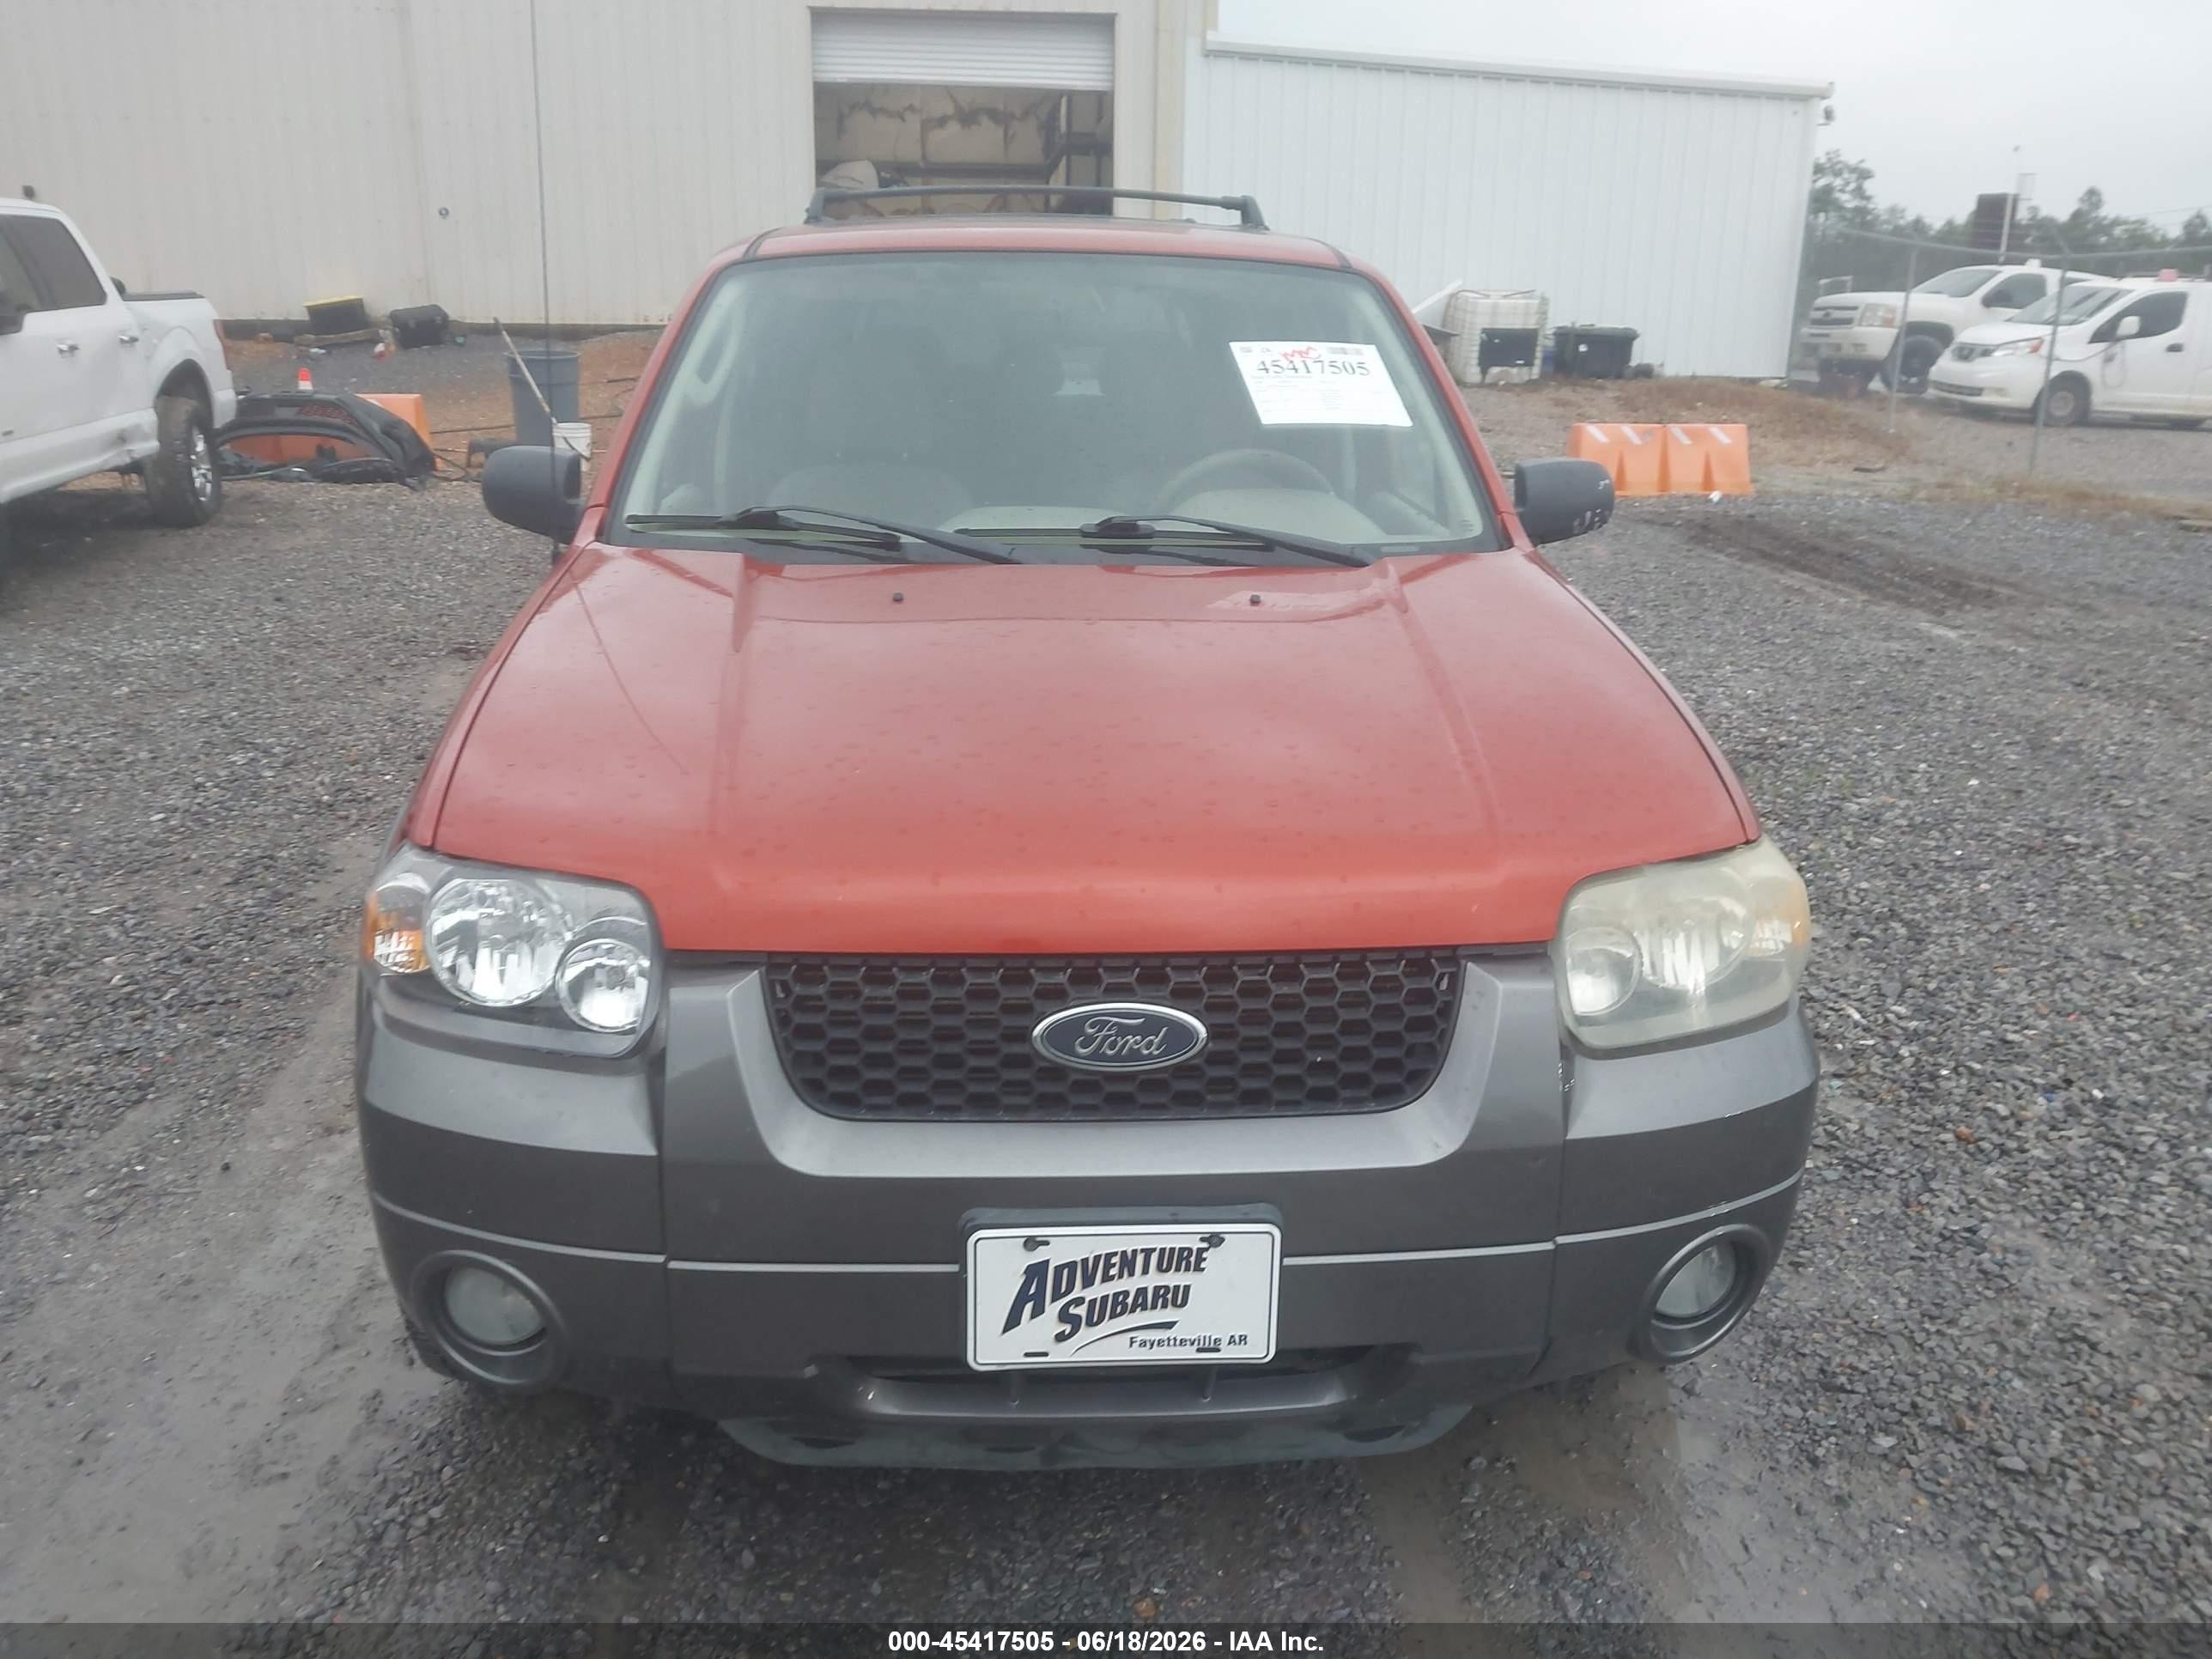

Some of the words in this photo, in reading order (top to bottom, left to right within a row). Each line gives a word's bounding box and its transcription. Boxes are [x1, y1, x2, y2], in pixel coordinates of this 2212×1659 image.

[1256, 359, 1370, 376] 45417505
[1075, 1016, 1167, 1056] Ford
[1054, 1284, 1191, 1342] SUBARU
[1128, 1334, 1222, 1350] Fayetteville
[1227, 1334, 1248, 1346] AR
